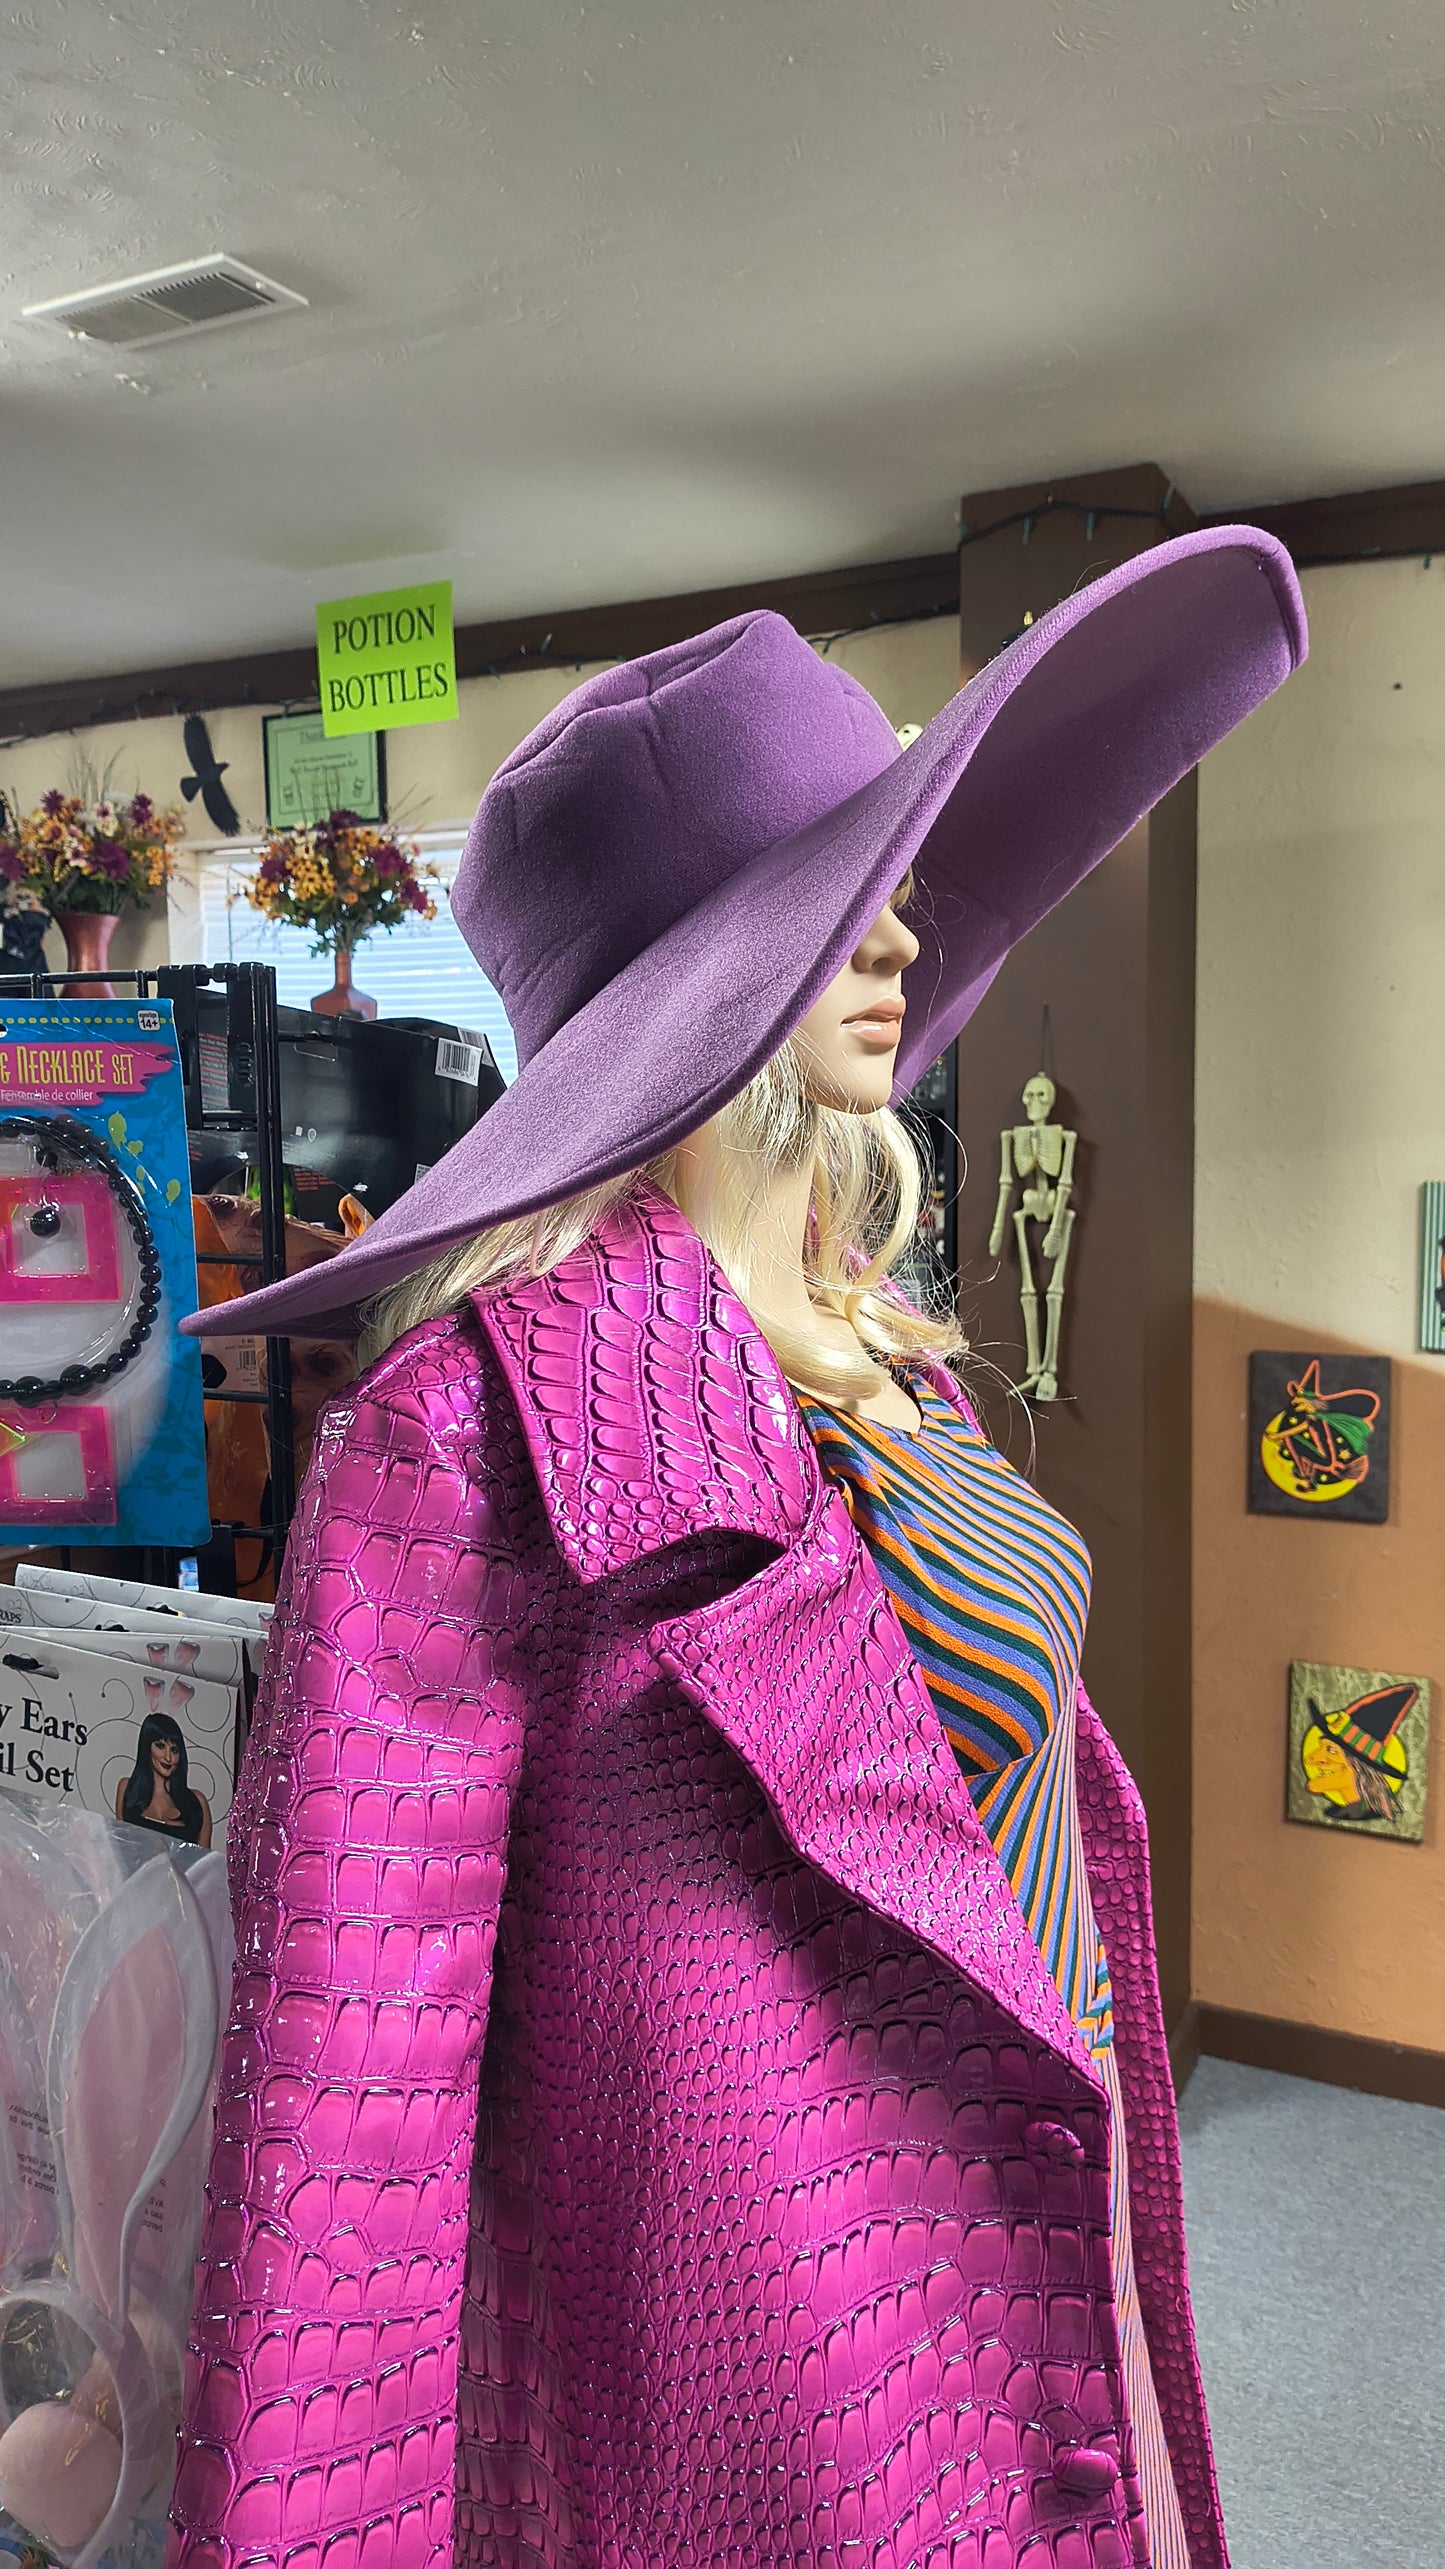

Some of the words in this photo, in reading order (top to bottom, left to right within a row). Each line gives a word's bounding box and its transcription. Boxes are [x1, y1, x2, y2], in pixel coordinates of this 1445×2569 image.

[332, 604, 436, 654] POTION
[328, 662, 448, 712] BOTTLES
[16, 1045, 106, 1085] NECKLACE
[112, 1054, 133, 1085] SET
[52, 1088, 63, 1101] de
[66, 1088, 93, 1101] collier
[20, 1697, 88, 1746] Ears
[26, 1750, 75, 1792] Set
